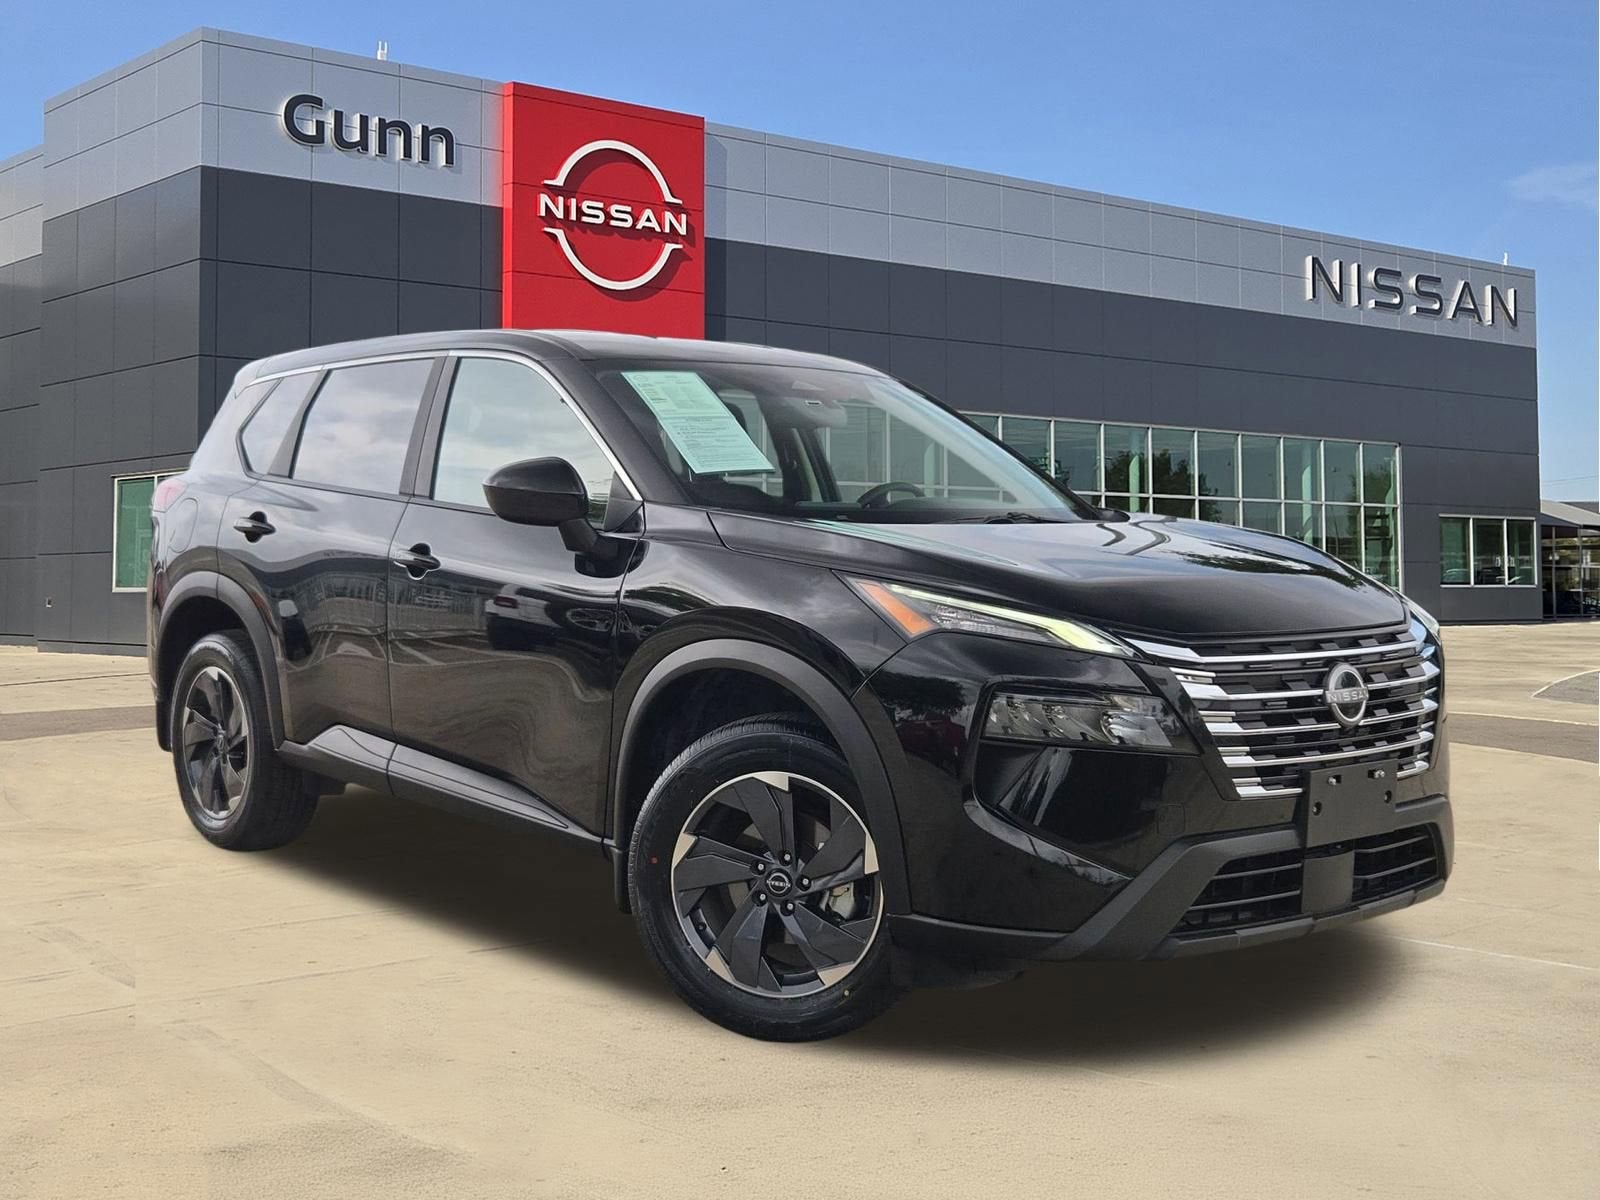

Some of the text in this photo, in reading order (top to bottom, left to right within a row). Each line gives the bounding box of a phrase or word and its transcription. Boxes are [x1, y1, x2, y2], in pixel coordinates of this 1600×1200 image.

[282, 94, 456, 167] Gunn
[537, 193, 688, 236] NISSAN
[1305, 255, 1519, 328] NISSAN
